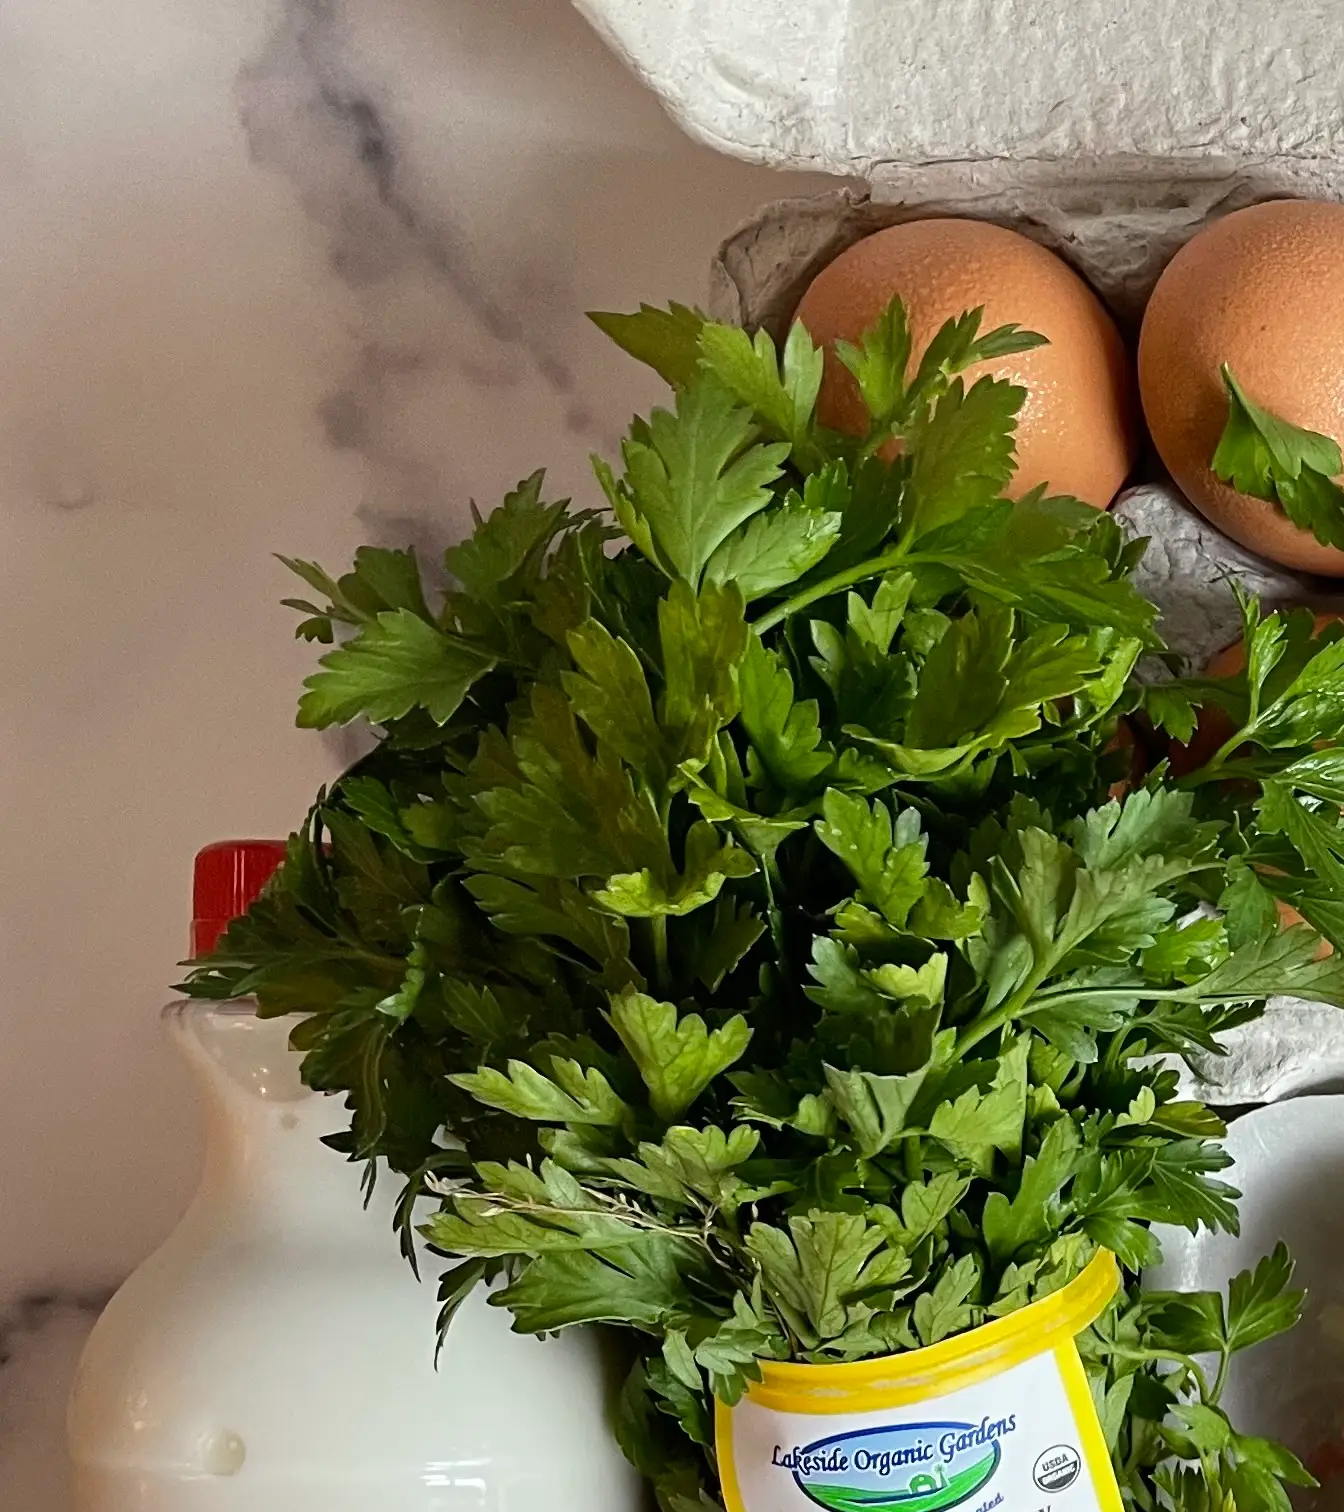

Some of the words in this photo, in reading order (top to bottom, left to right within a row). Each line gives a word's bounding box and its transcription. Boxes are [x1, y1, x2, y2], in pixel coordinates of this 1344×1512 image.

[771, 1444, 849, 1475] Lakeside
[854, 1439, 934, 1477] Organic
[939, 1412, 1017, 1464] Gardens
[1042, 1453, 1069, 1472] USDA
